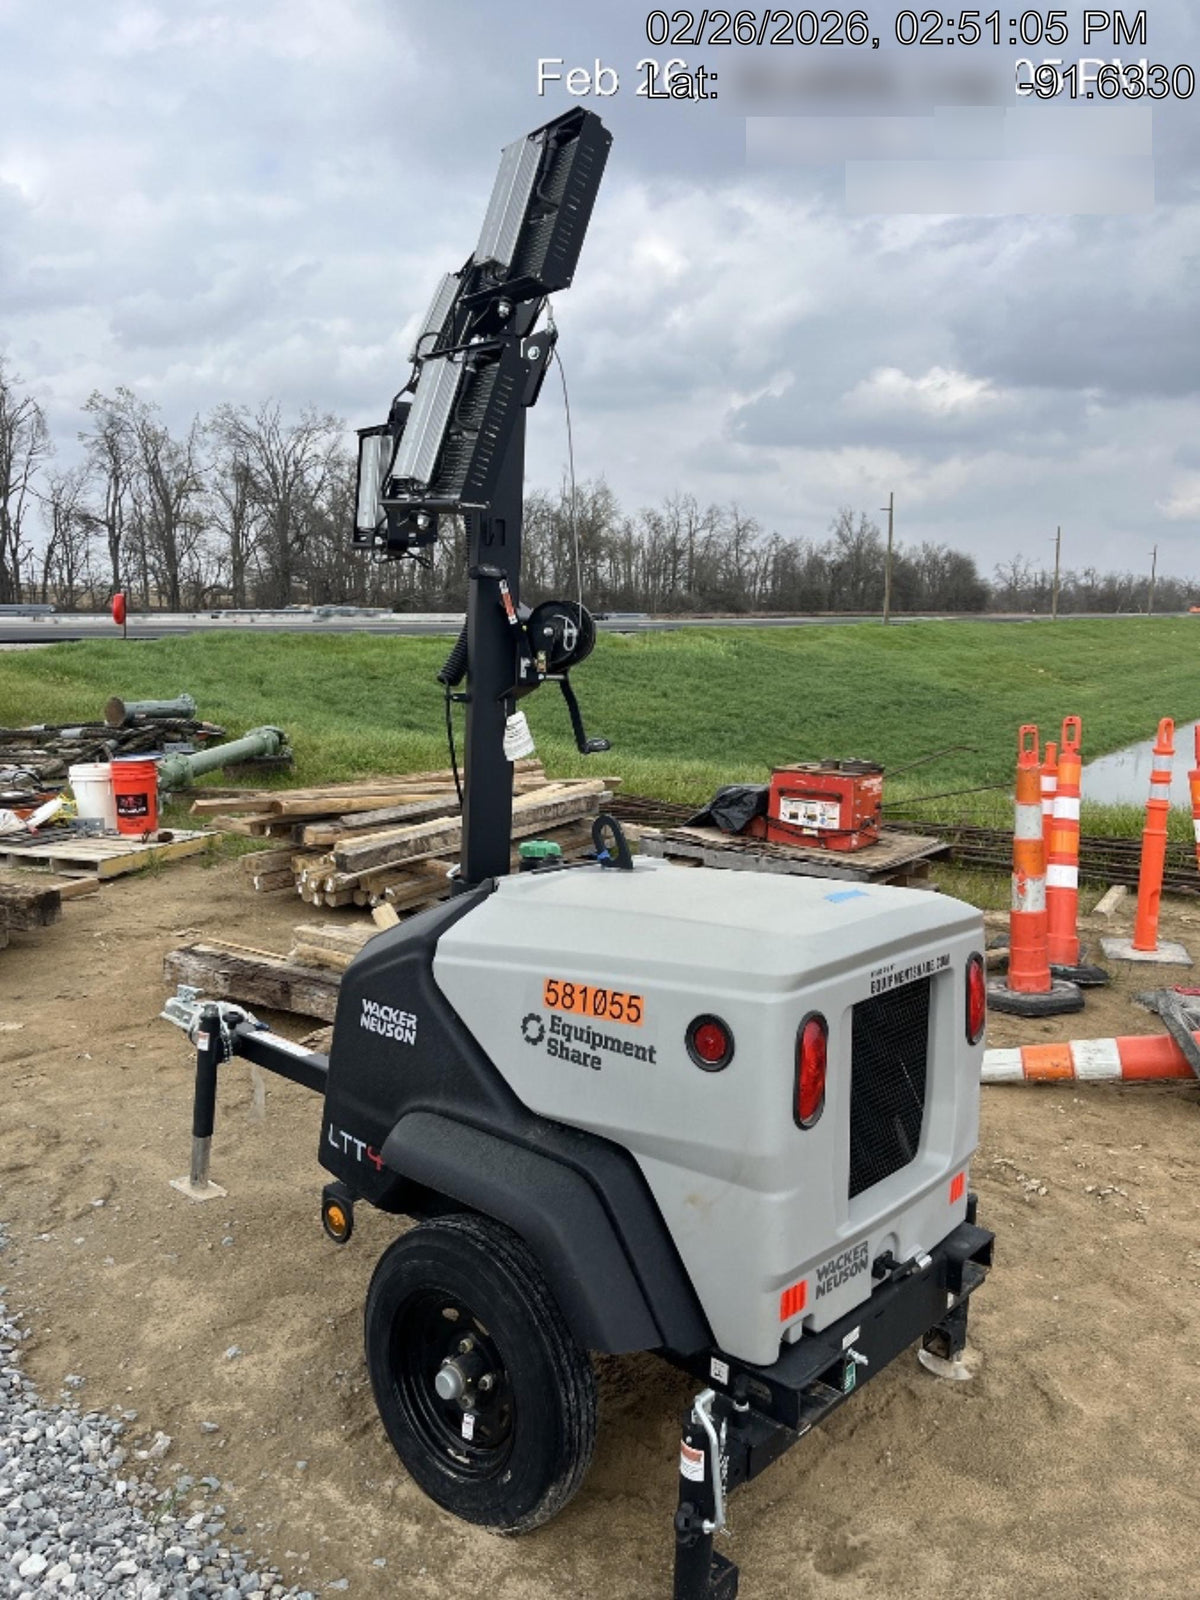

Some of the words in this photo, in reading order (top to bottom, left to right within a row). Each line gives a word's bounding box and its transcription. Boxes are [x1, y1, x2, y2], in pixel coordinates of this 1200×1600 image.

[361, 998, 417, 1030] WACKER
[545, 979, 642, 1023] 581055
[360, 1012, 417, 1046] NEUSON
[549, 1014, 657, 1065] Equipment
[546, 1037, 602, 1071] Share
[815, 1254, 869, 1300] NEUSON
[816, 1240, 869, 1283] WACKER
